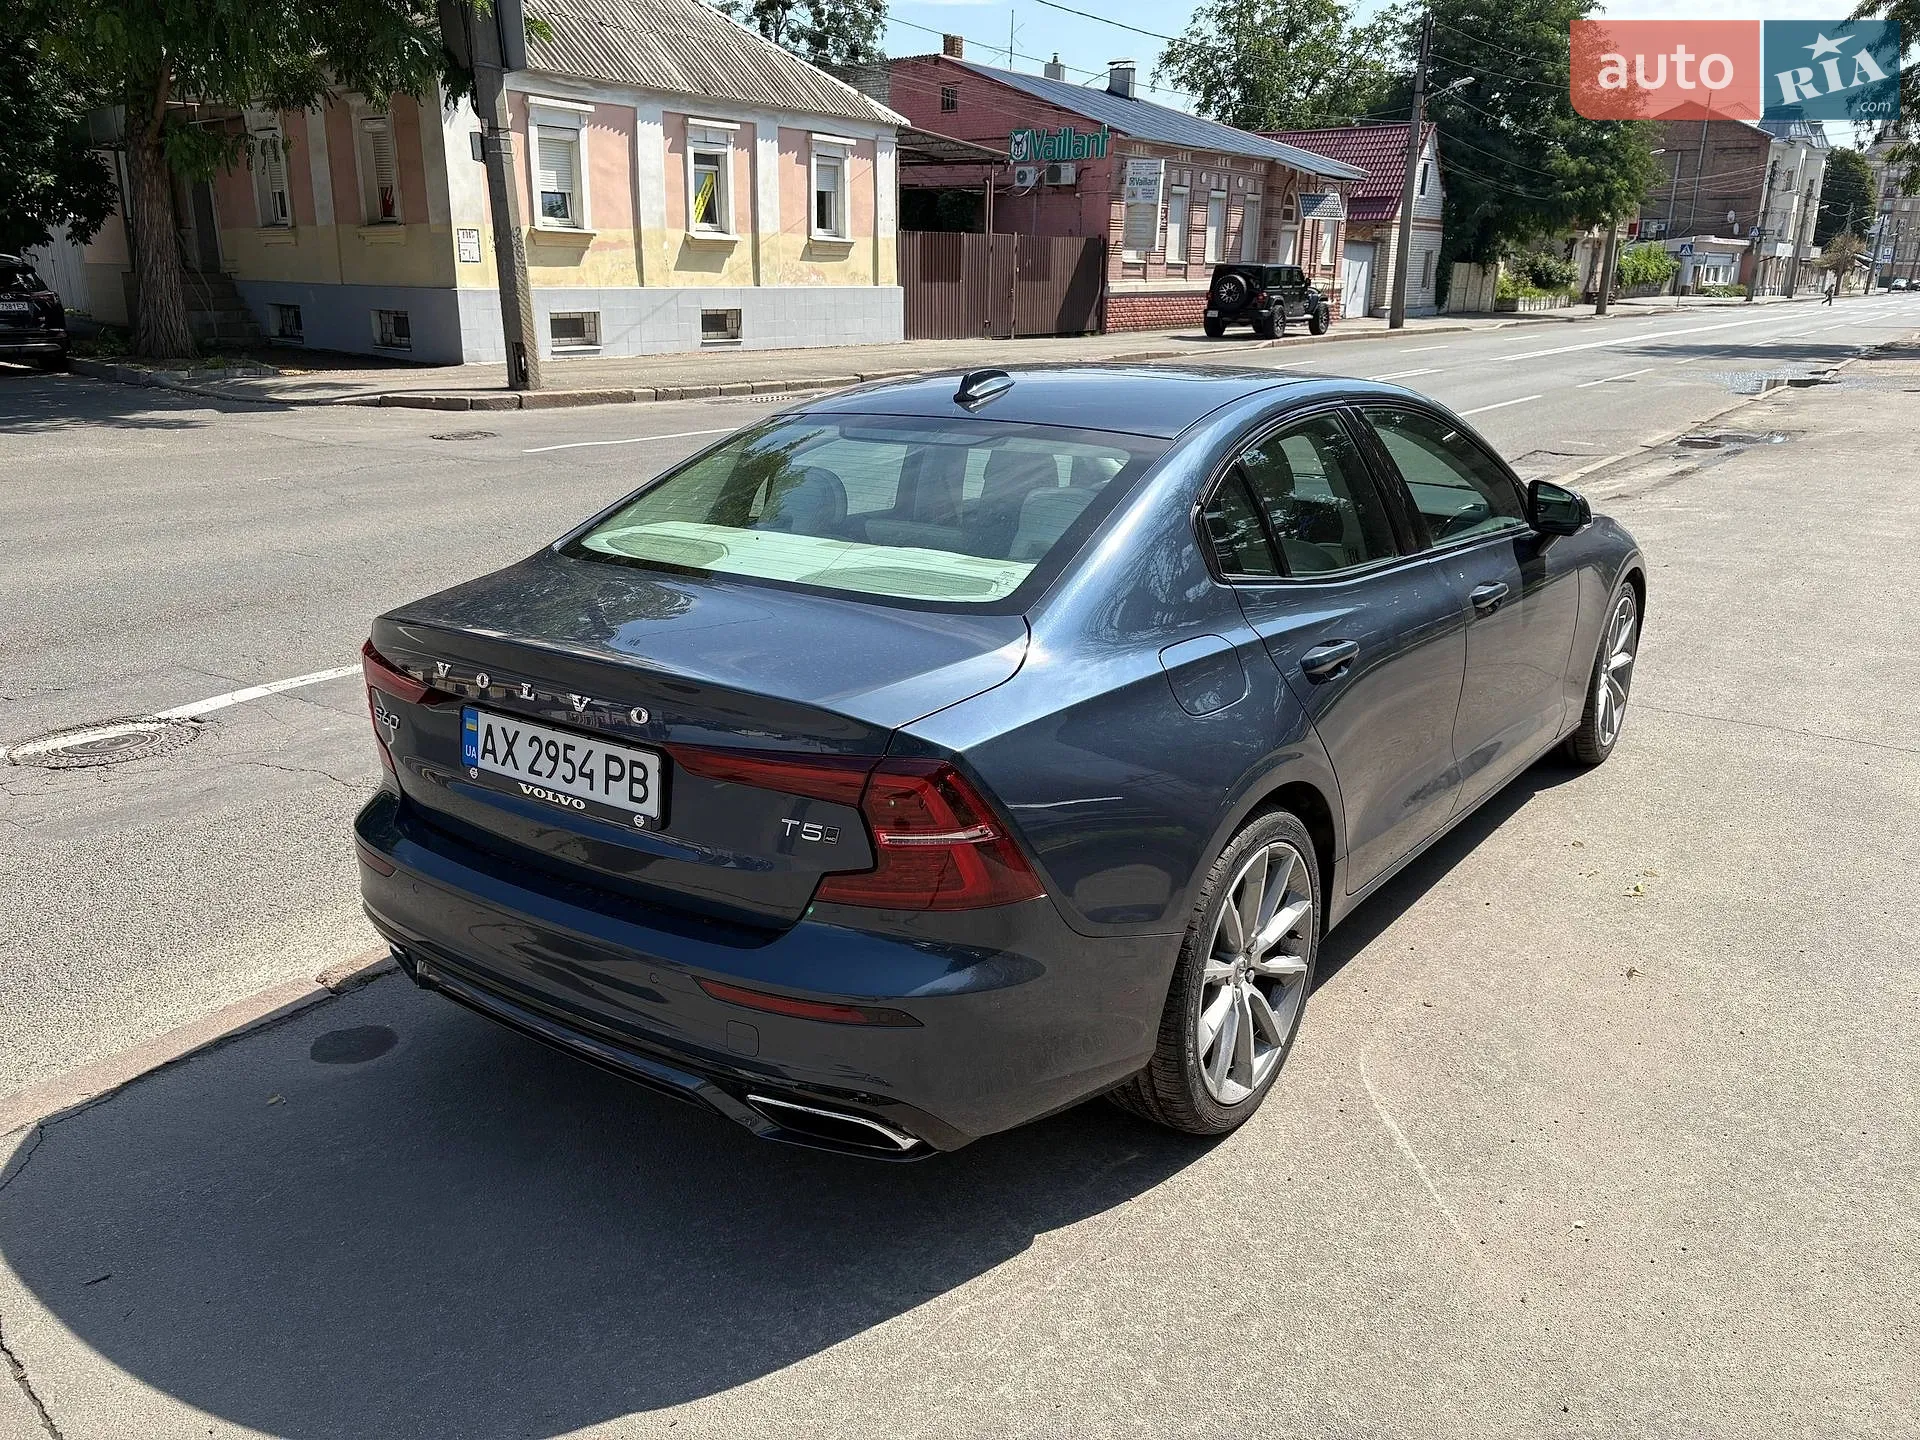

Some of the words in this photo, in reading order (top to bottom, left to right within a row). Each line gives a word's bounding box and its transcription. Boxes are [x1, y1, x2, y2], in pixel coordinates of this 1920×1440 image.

[1029, 124, 1111, 160] Vaillant
[436, 661, 649, 725] VOLVO
[375, 706, 400, 730] S60
[465, 744, 478, 759] UA
[480, 723, 520, 771] AX
[527, 735, 594, 791] 2954
[604, 753, 649, 804] PB
[518, 782, 586, 810] VOLVO
[781, 818, 823, 842] T5
